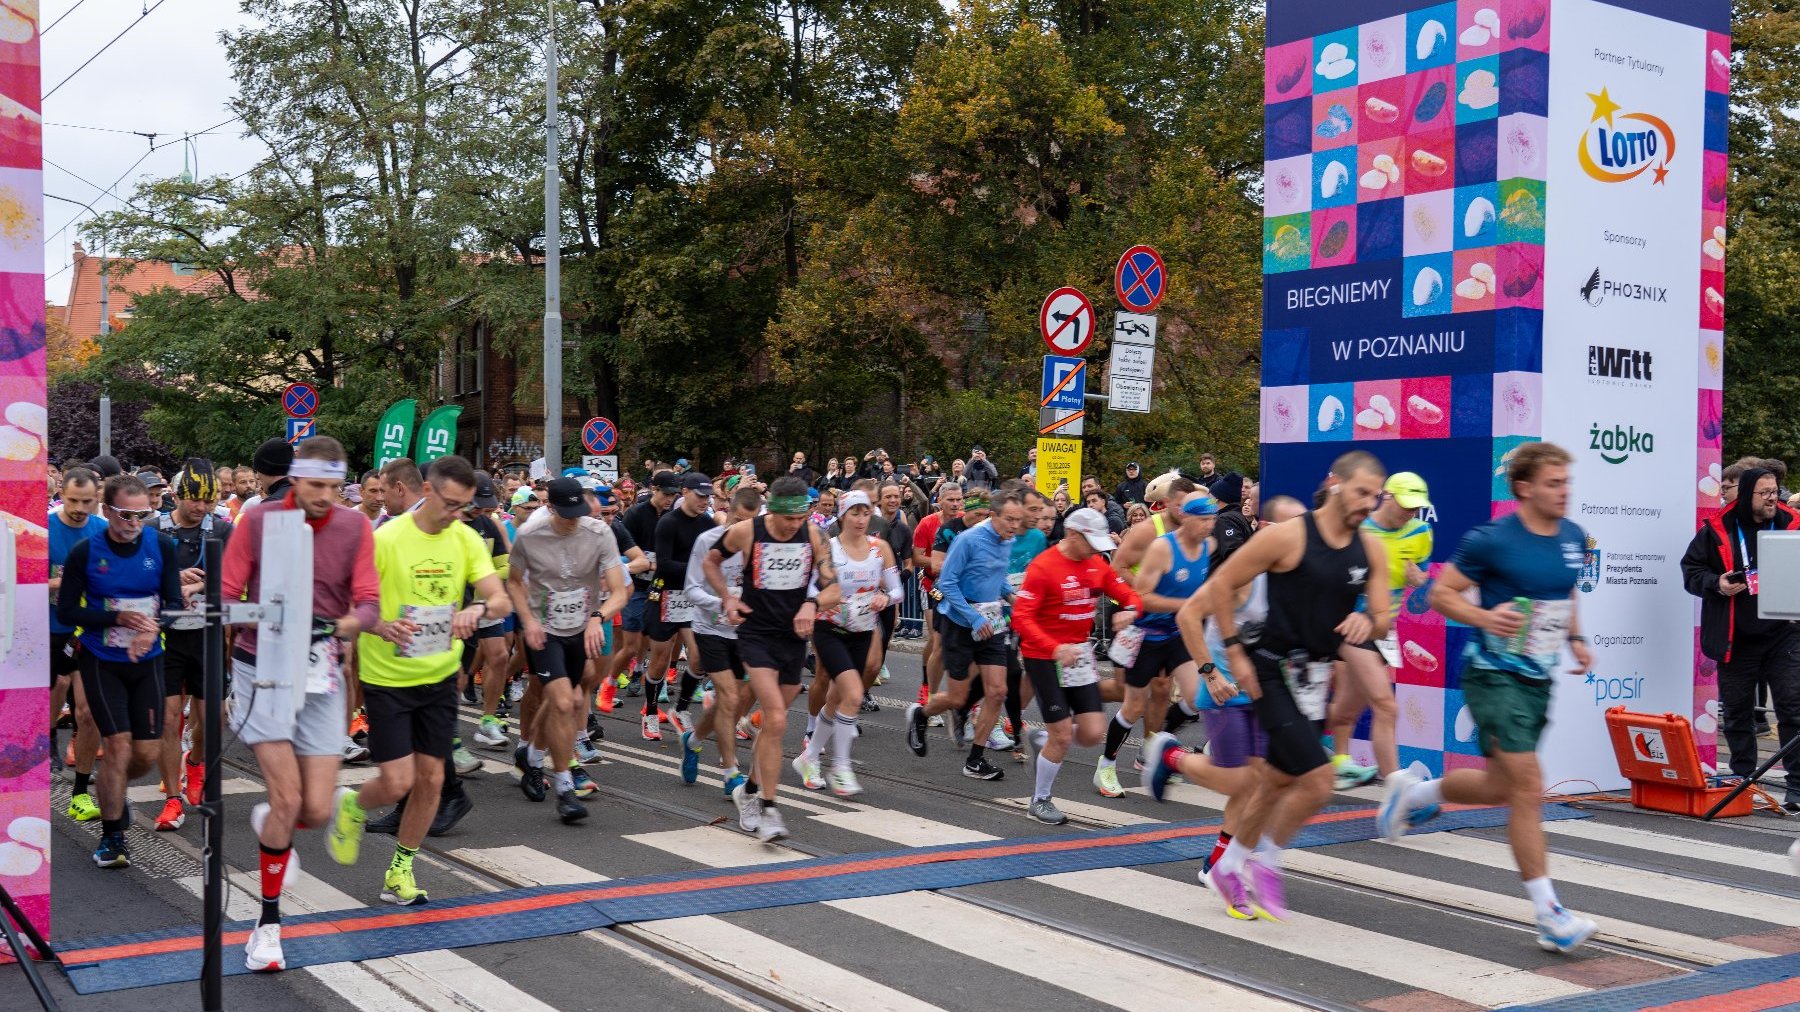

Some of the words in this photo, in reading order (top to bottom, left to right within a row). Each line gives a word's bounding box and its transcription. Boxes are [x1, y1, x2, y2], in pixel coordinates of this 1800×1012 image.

[1594, 48, 1626, 64] Partner
[1627, 55, 1664, 76] Tytularny
[1598, 127, 1657, 167] LOTTO
[1603, 230, 1647, 250] Sponsorzy
[1287, 278, 1392, 310] BIEGNIEMY
[1331, 340, 1353, 361] W
[1358, 330, 1465, 360] POZNANIU
[1597, 346, 1652, 381] Witt
[1061, 395, 1082, 406] Płatny
[1589, 422, 1654, 453] żabka
[1042, 442, 1077, 453] UWAGA!
[1581, 503, 1618, 515] Patronat
[1620, 504, 1662, 519] Honorowy
[1606, 552, 1633, 561] Patronat
[1635, 553, 1666, 562] Honorowy
[767, 558, 802, 571] 2569
[1606, 564, 1643, 574] Prezydenta
[1606, 576, 1628, 584] Miasta
[1629, 576, 1658, 585] Poznania
[554, 601, 583, 614] 4189
[670, 600, 695, 610] 3434
[1593, 634, 1644, 648] Organizator
